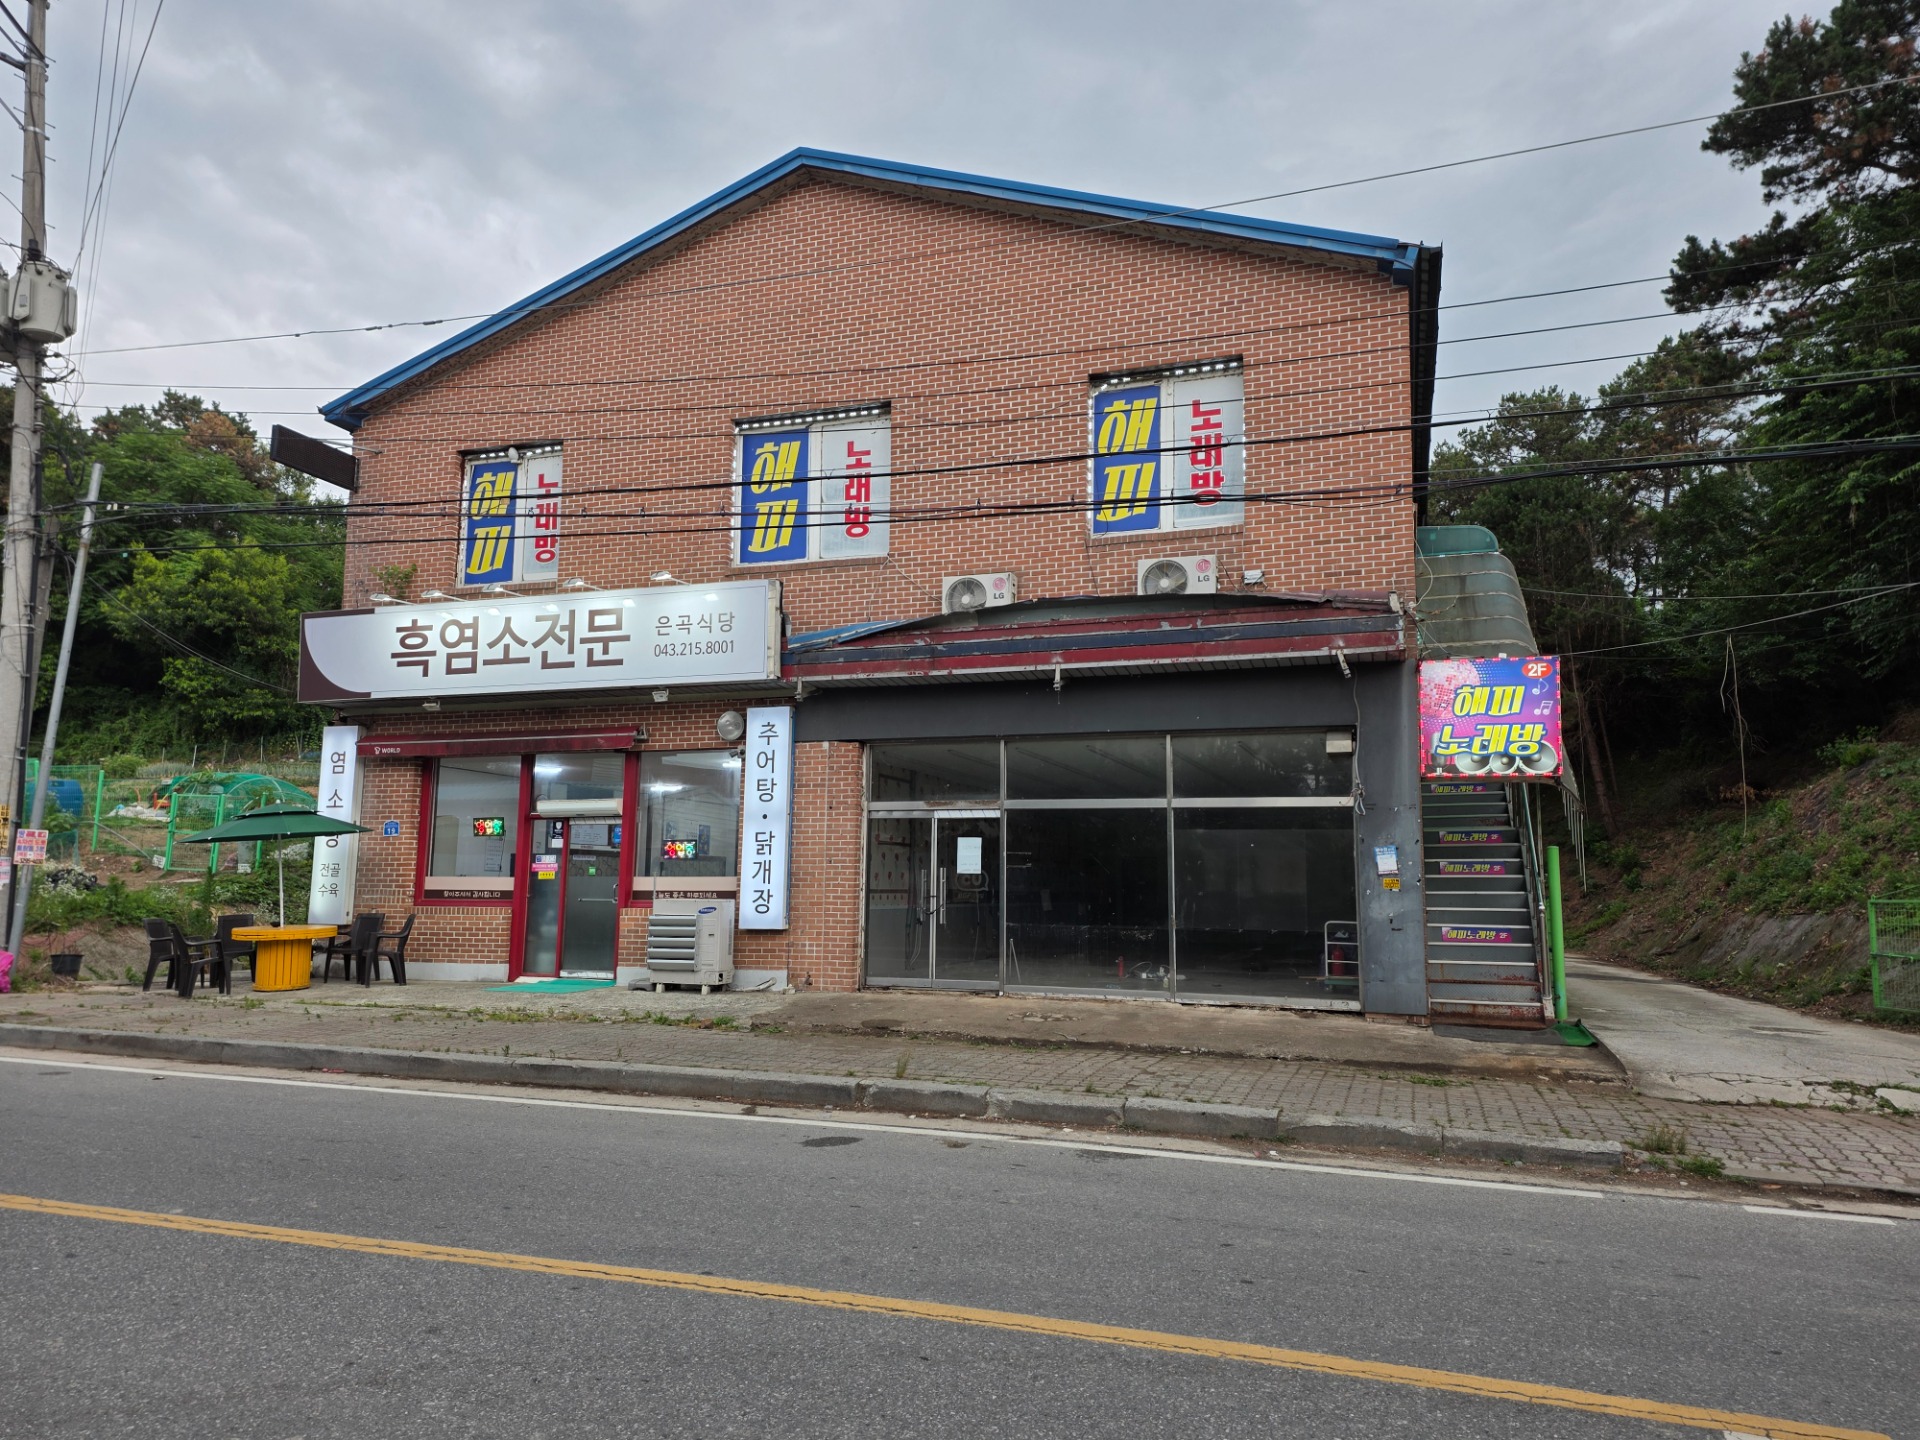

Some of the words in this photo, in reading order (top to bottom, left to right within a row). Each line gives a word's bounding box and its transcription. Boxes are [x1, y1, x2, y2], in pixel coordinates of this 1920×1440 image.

[1096, 397, 1158, 523] 해피
[1189, 399, 1227, 507] 노래방
[748, 440, 802, 554] 해피
[844, 440, 872, 539] 노래방
[466, 471, 515, 575] 해피
[533, 473, 558, 563] 노래방
[1197, 575, 1210, 583] LG
[993, 592, 1005, 600] LG
[655, 612, 736, 637] 은곡식당
[390, 607, 632, 678] 흑염소전문
[654, 639, 735, 658] 043.215.8001
[1527, 663, 1548, 678] 2F
[1454, 685, 1525, 716] 해피
[1437, 723, 1547, 756] 노래방
[756, 721, 779, 803] 추어탕
[1443, 832, 1488, 842] 해피노래방
[319, 863, 341, 878] 전골
[752, 830, 776, 914] 닭개장
[1444, 863, 1491, 873] 해피노래방
[318, 882, 340, 898] 수육
[1447, 929, 1497, 940] 해피노래방
